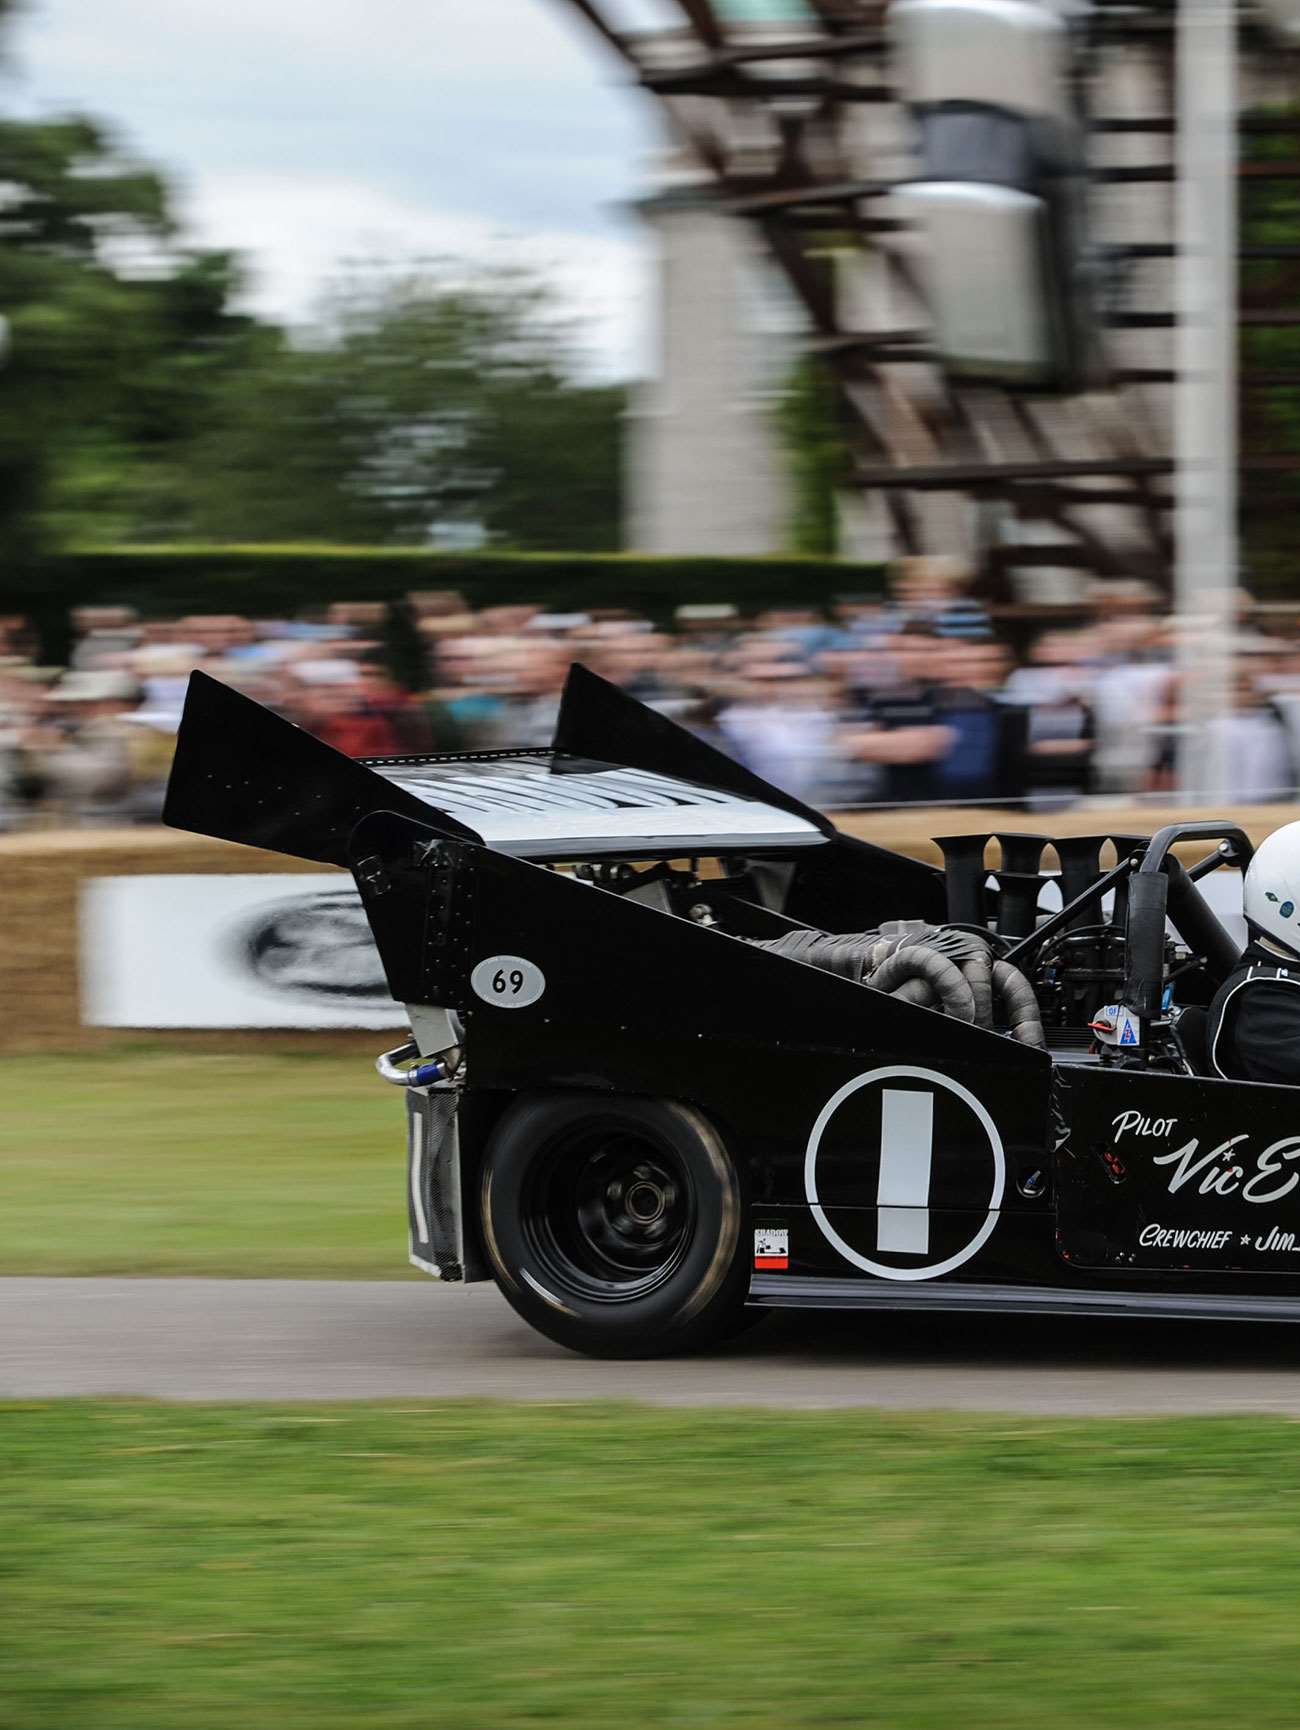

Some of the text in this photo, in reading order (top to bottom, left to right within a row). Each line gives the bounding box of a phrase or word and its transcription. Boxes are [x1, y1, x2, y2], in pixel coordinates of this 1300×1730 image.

[492, 968, 524, 994] 69
[1153, 1134, 1250, 1195] Vic
[1138, 1223, 1233, 1249] CREWCHIEF
